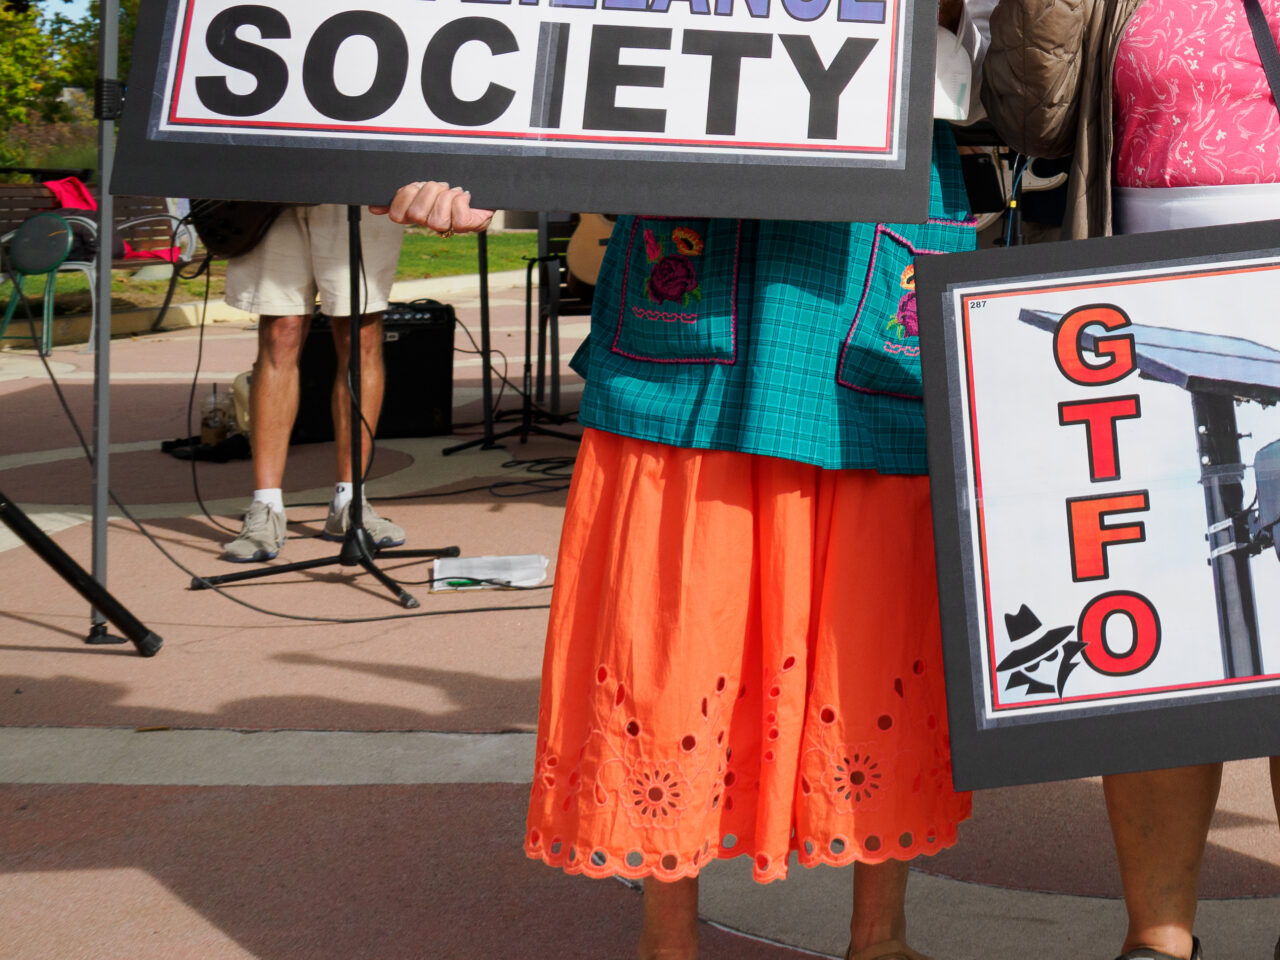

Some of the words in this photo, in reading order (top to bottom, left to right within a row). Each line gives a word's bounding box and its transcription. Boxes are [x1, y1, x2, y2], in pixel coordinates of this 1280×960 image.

[194, 4, 879, 140] SOCIETY
[970, 300, 986, 308] 287
[1053, 302, 1162, 678] GTFO
